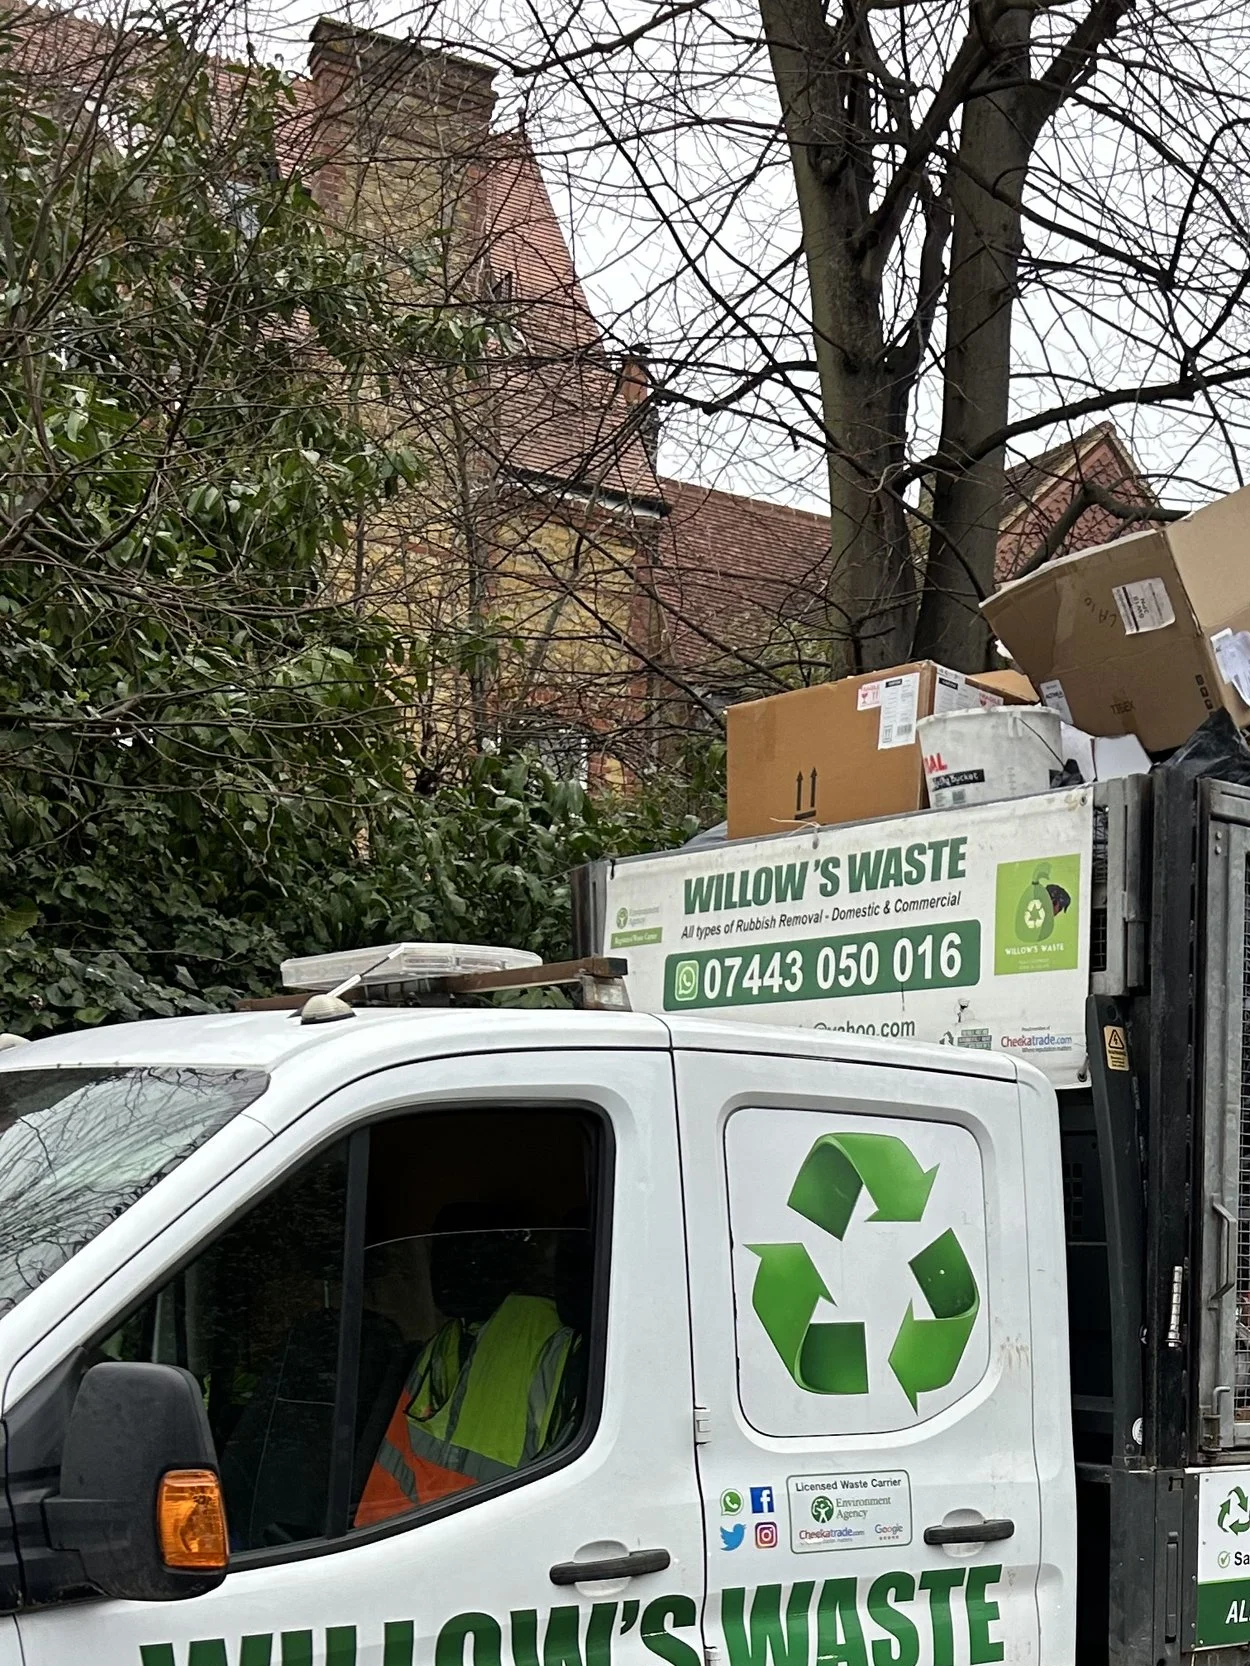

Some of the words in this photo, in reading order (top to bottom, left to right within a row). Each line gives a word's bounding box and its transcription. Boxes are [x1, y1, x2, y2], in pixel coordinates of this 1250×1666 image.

[684, 856, 841, 915] WILLOW'S
[848, 837, 968, 893] WASTE
[681, 919, 695, 939] All
[697, 918, 721, 940] types
[724, 916, 735, 934] of
[736, 912, 776, 932] Rubbish
[778, 906, 823, 928] Removal
[831, 901, 880, 921] Domestic
[883, 900, 891, 914] &
[894, 891, 962, 912] Commercial
[1005, 944, 1038, 955] WILLOW'S
[1041, 943, 1064, 952] WASTE
[704, 950, 804, 999] 07443
[816, 942, 879, 990] 050
[893, 932, 962, 982] 016
[796, 1481, 838, 1491] Licensed
[841, 1480, 868, 1489] Waste
[871, 1478, 901, 1487] Carrier
[836, 1496, 891, 1507] Environment
[837, 1509, 868, 1520] Agency
[875, 1523, 903, 1535] Google
